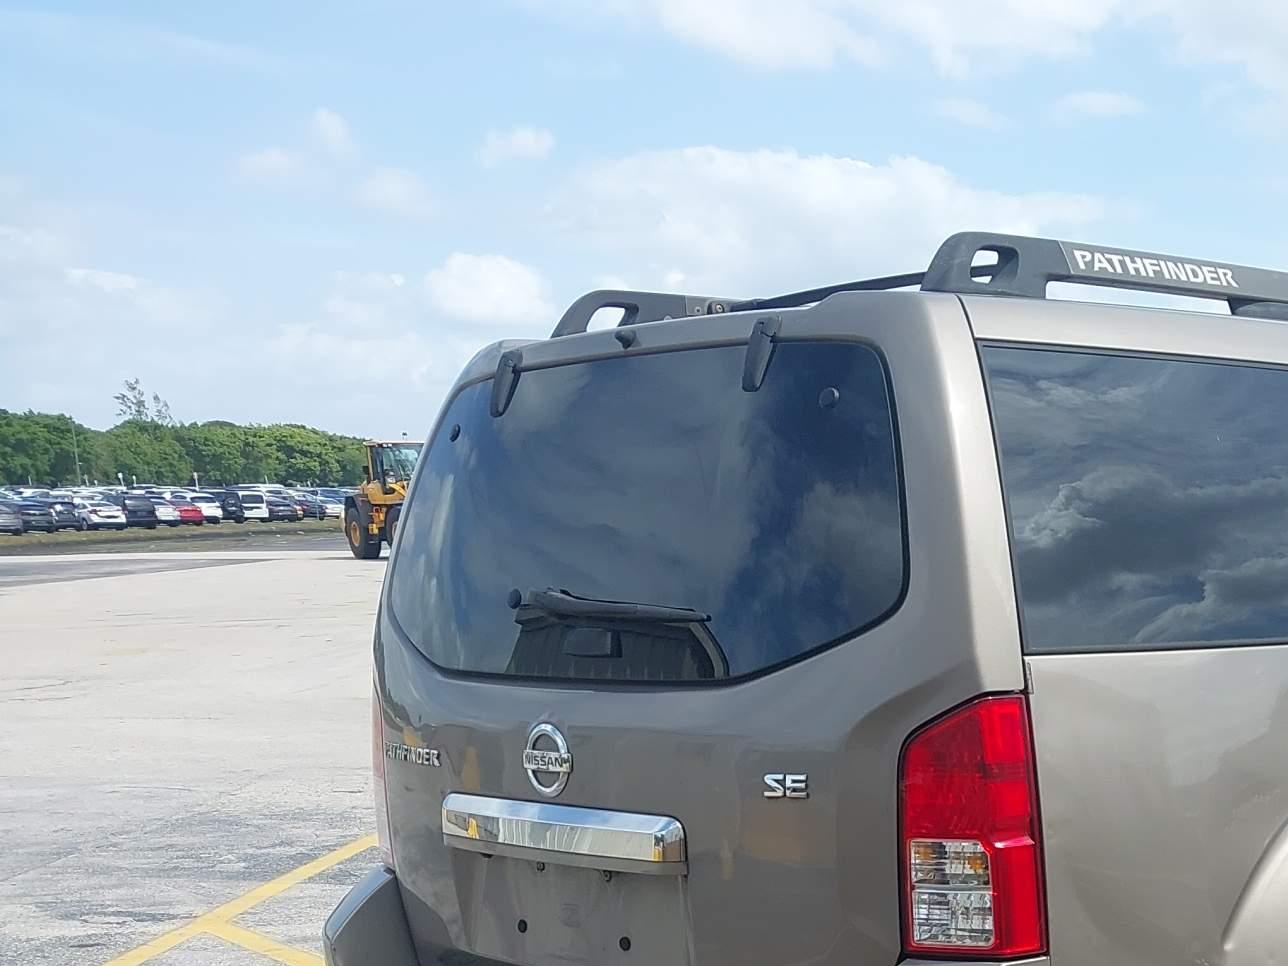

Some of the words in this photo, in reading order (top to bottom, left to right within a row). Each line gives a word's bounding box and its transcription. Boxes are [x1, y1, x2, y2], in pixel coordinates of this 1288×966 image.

[1073, 250, 1239, 287] PATHFINDER
[525, 752, 572, 772] NISSAN
[763, 774, 808, 798] SE
